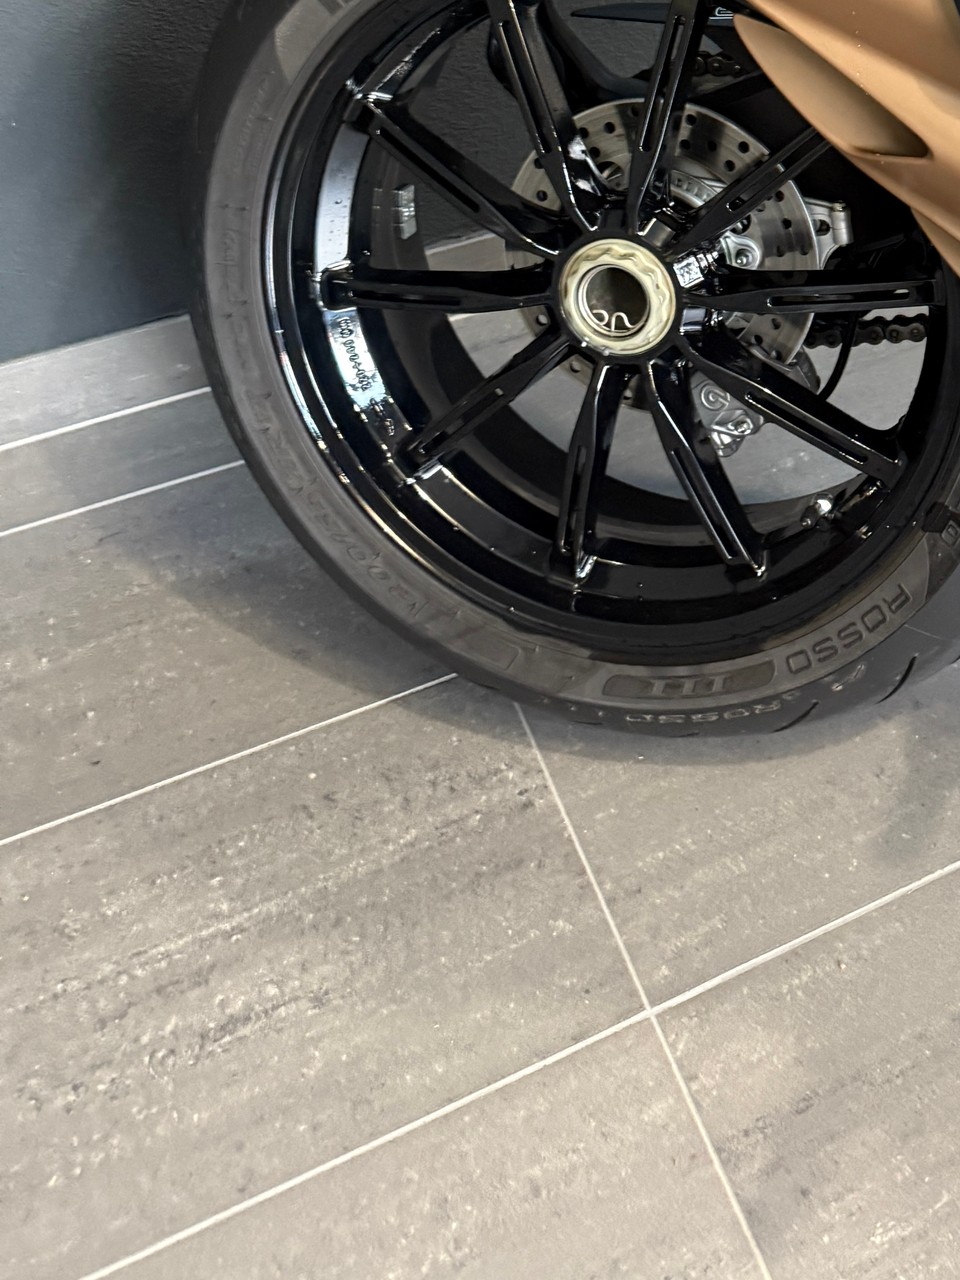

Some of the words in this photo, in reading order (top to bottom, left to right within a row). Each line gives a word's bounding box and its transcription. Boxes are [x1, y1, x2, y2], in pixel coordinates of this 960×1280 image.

[785, 583, 913, 675] ROSSO
[651, 675, 729, 697] III
[626, 700, 782, 724] ROSSO
